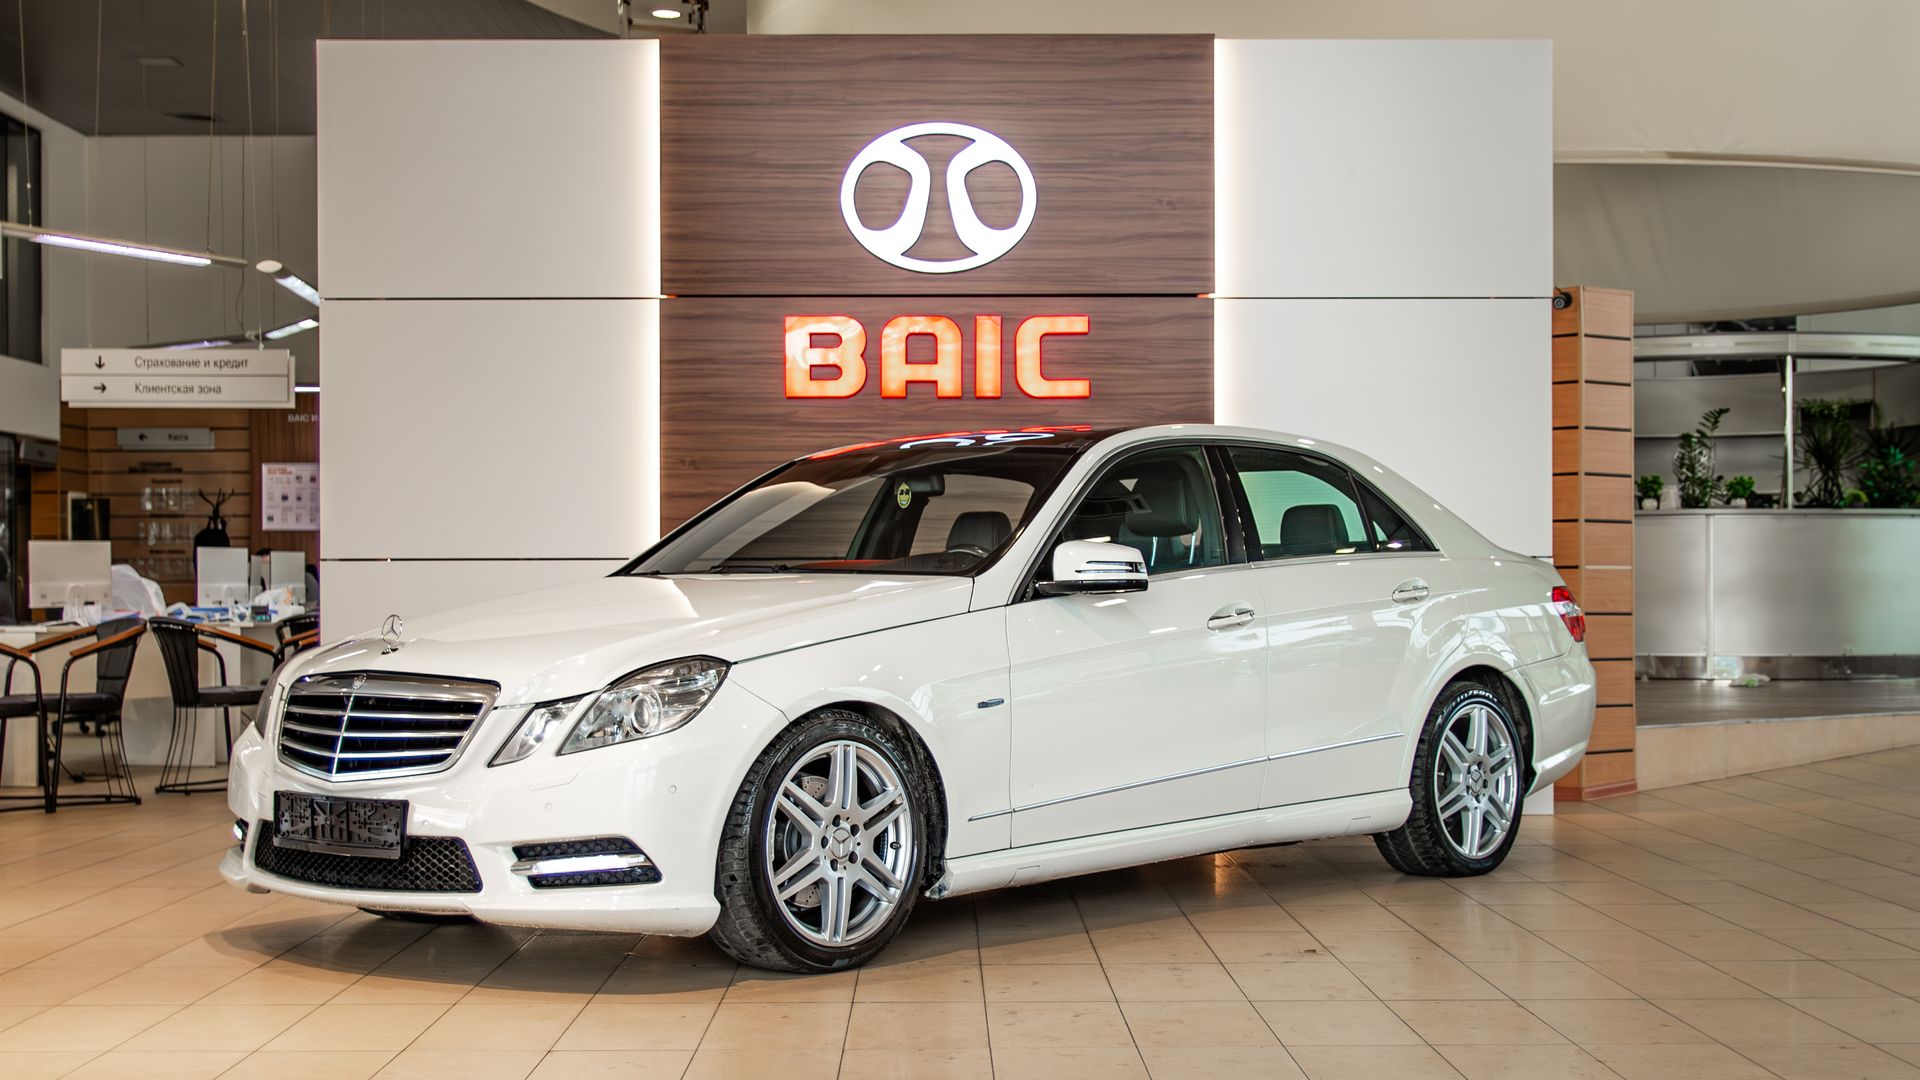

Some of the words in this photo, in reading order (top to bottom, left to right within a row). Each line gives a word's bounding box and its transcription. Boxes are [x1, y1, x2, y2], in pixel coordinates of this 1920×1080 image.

[134, 355, 201, 370] Страхование
[203, 359, 211, 368] и
[213, 358, 249, 370] кредит
[784, 315, 1091, 399] BAIC
[134, 382, 195, 394] Клиентская
[197, 384, 222, 394] зона
